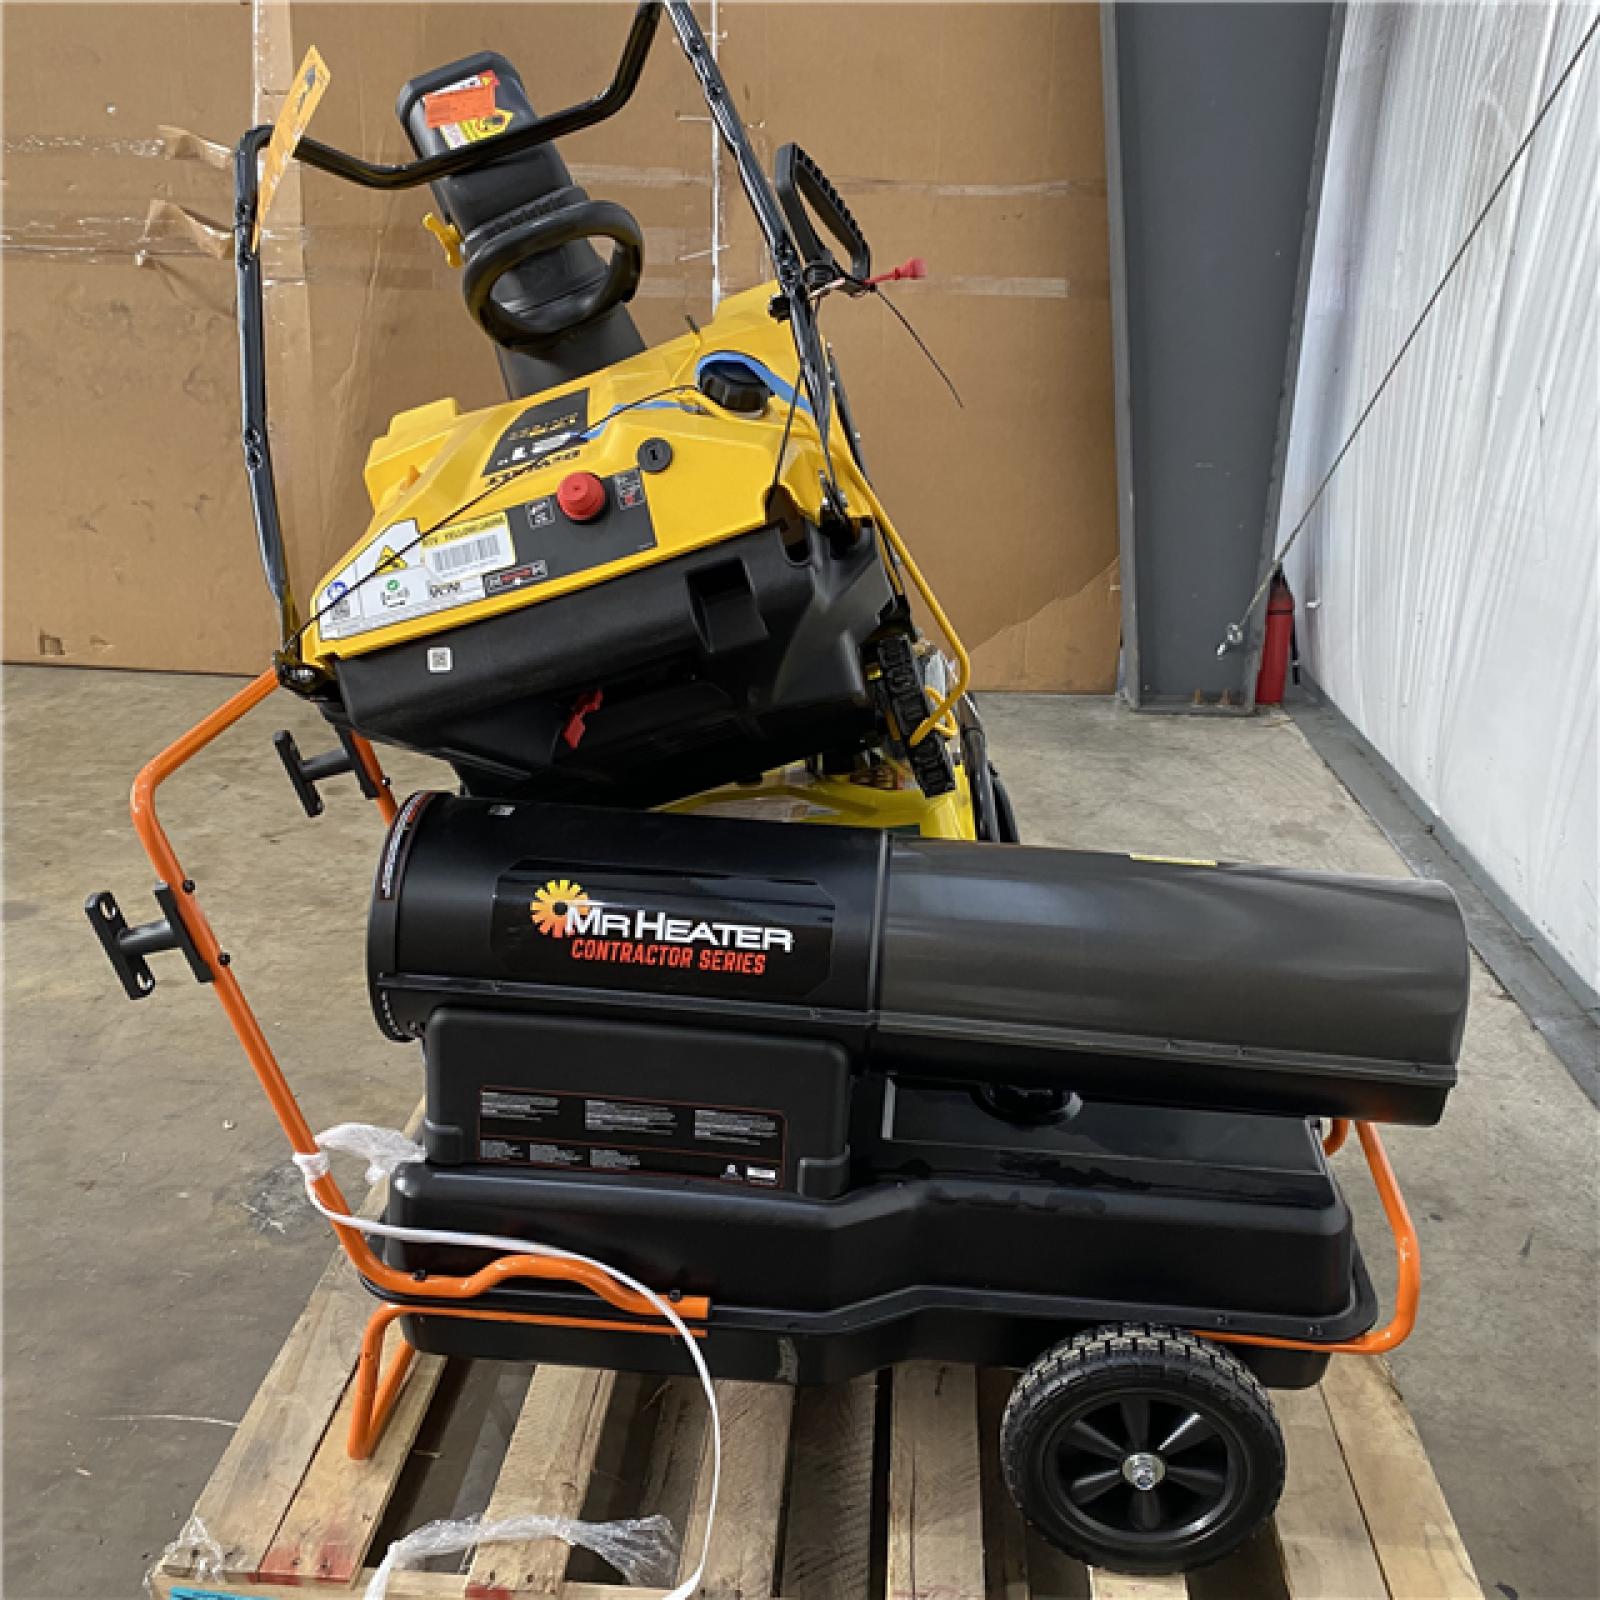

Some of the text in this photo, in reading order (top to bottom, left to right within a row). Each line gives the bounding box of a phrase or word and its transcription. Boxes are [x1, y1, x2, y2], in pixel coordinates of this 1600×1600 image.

[635, 911, 793, 952] HEATER
[571, 939, 767, 976] CONTRACTOR SERIES
